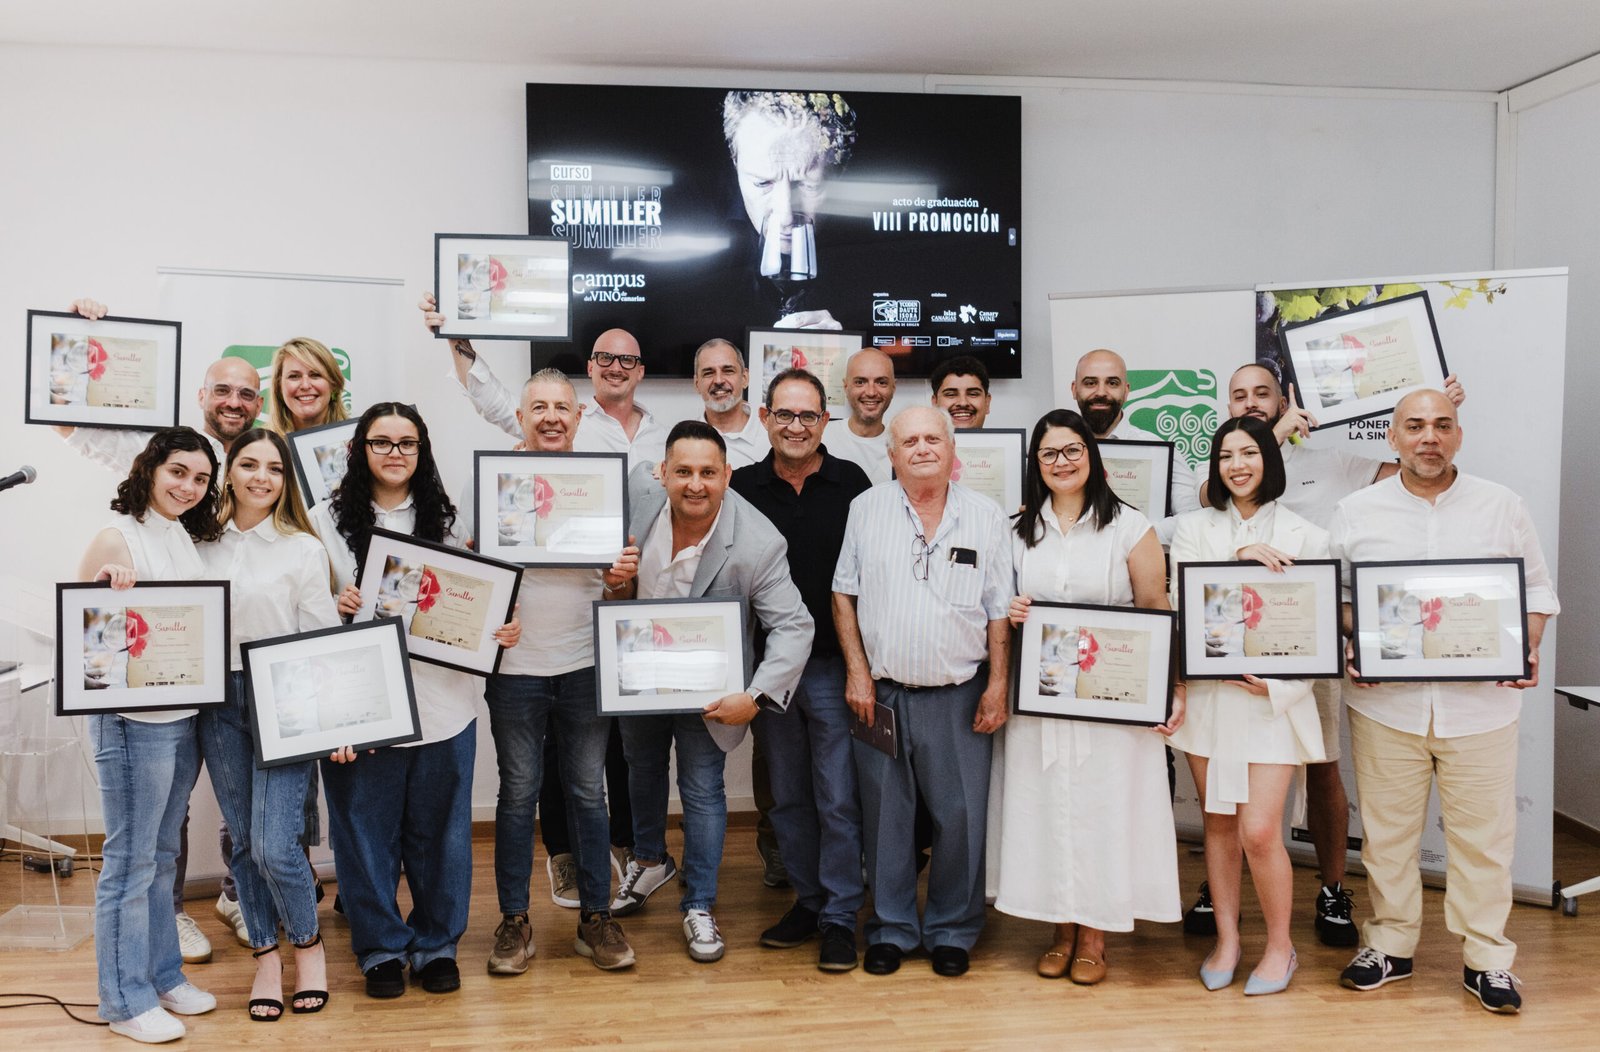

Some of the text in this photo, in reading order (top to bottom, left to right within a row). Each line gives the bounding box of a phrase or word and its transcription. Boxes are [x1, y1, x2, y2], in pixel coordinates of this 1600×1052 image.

[553, 167, 590, 179] curso
[893, 197, 979, 208] acto de graduación
[551, 200, 661, 225] SUMILLER
[873, 208, 999, 232] VIII PROMOCIÓN
[572, 273, 646, 294] Campus
[590, 290, 621, 302] VINO
[1349, 420, 1390, 429] PONER
[1349, 431, 1364, 440] LA
[155, 622, 187, 632] Sumiller
